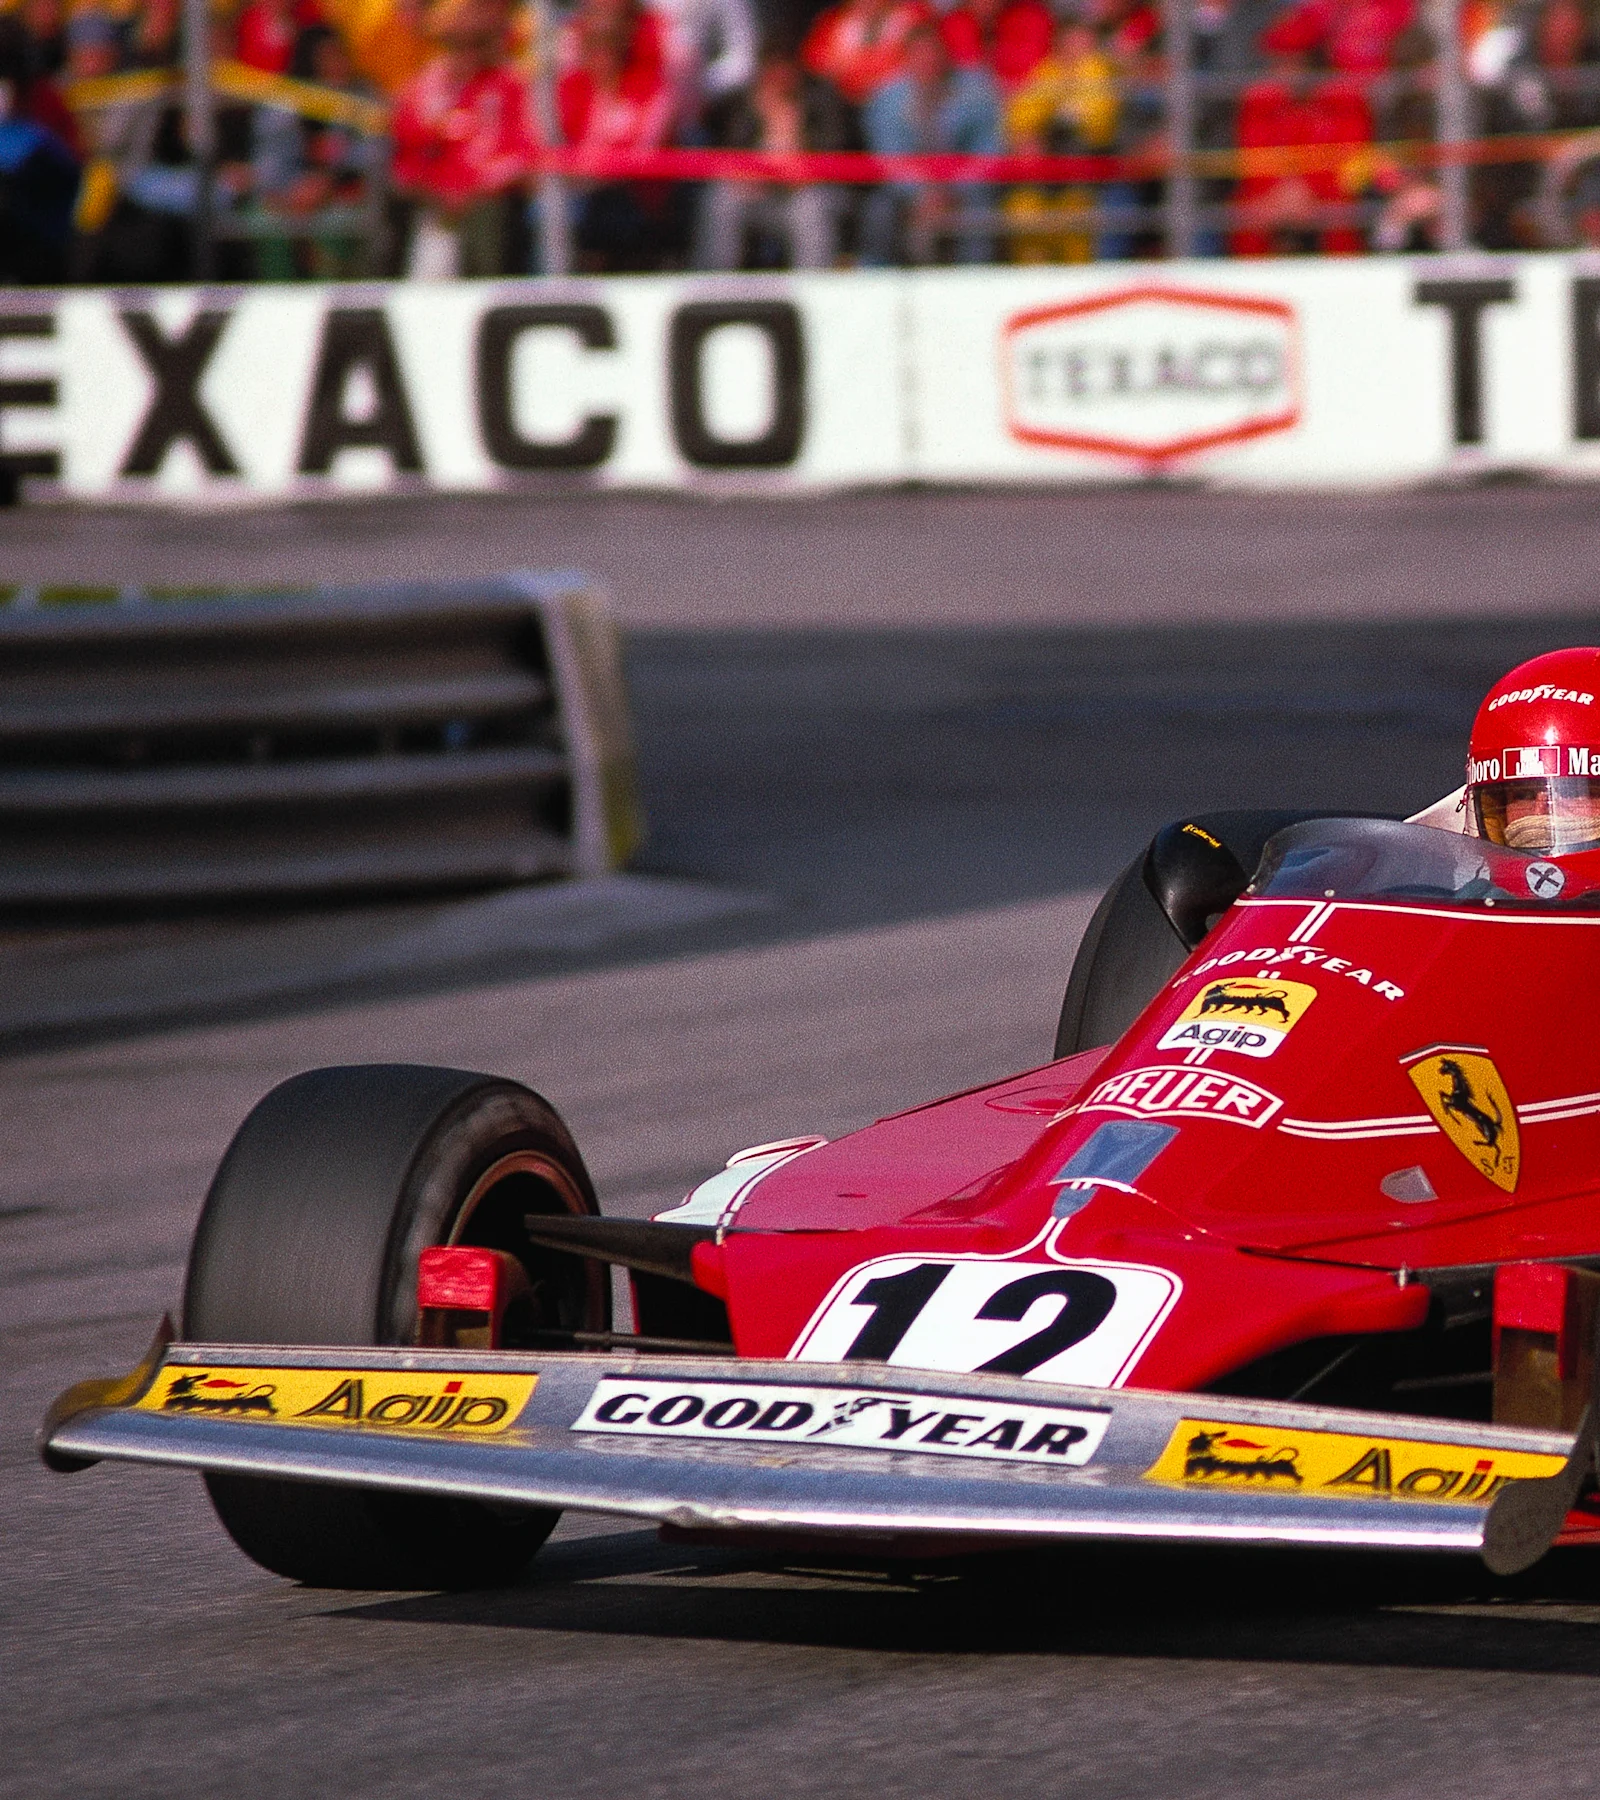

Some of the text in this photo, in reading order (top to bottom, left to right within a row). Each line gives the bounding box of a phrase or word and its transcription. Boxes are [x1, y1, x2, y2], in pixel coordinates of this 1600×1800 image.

[1024, 338, 1284, 398] TEXACO
[1172, 1023, 1267, 1049] Agip
[1097, 1068, 1262, 1117] HEUER
[850, 1262, 1119, 1376] 12
[594, 1393, 1092, 1457] GOOD YEAR
